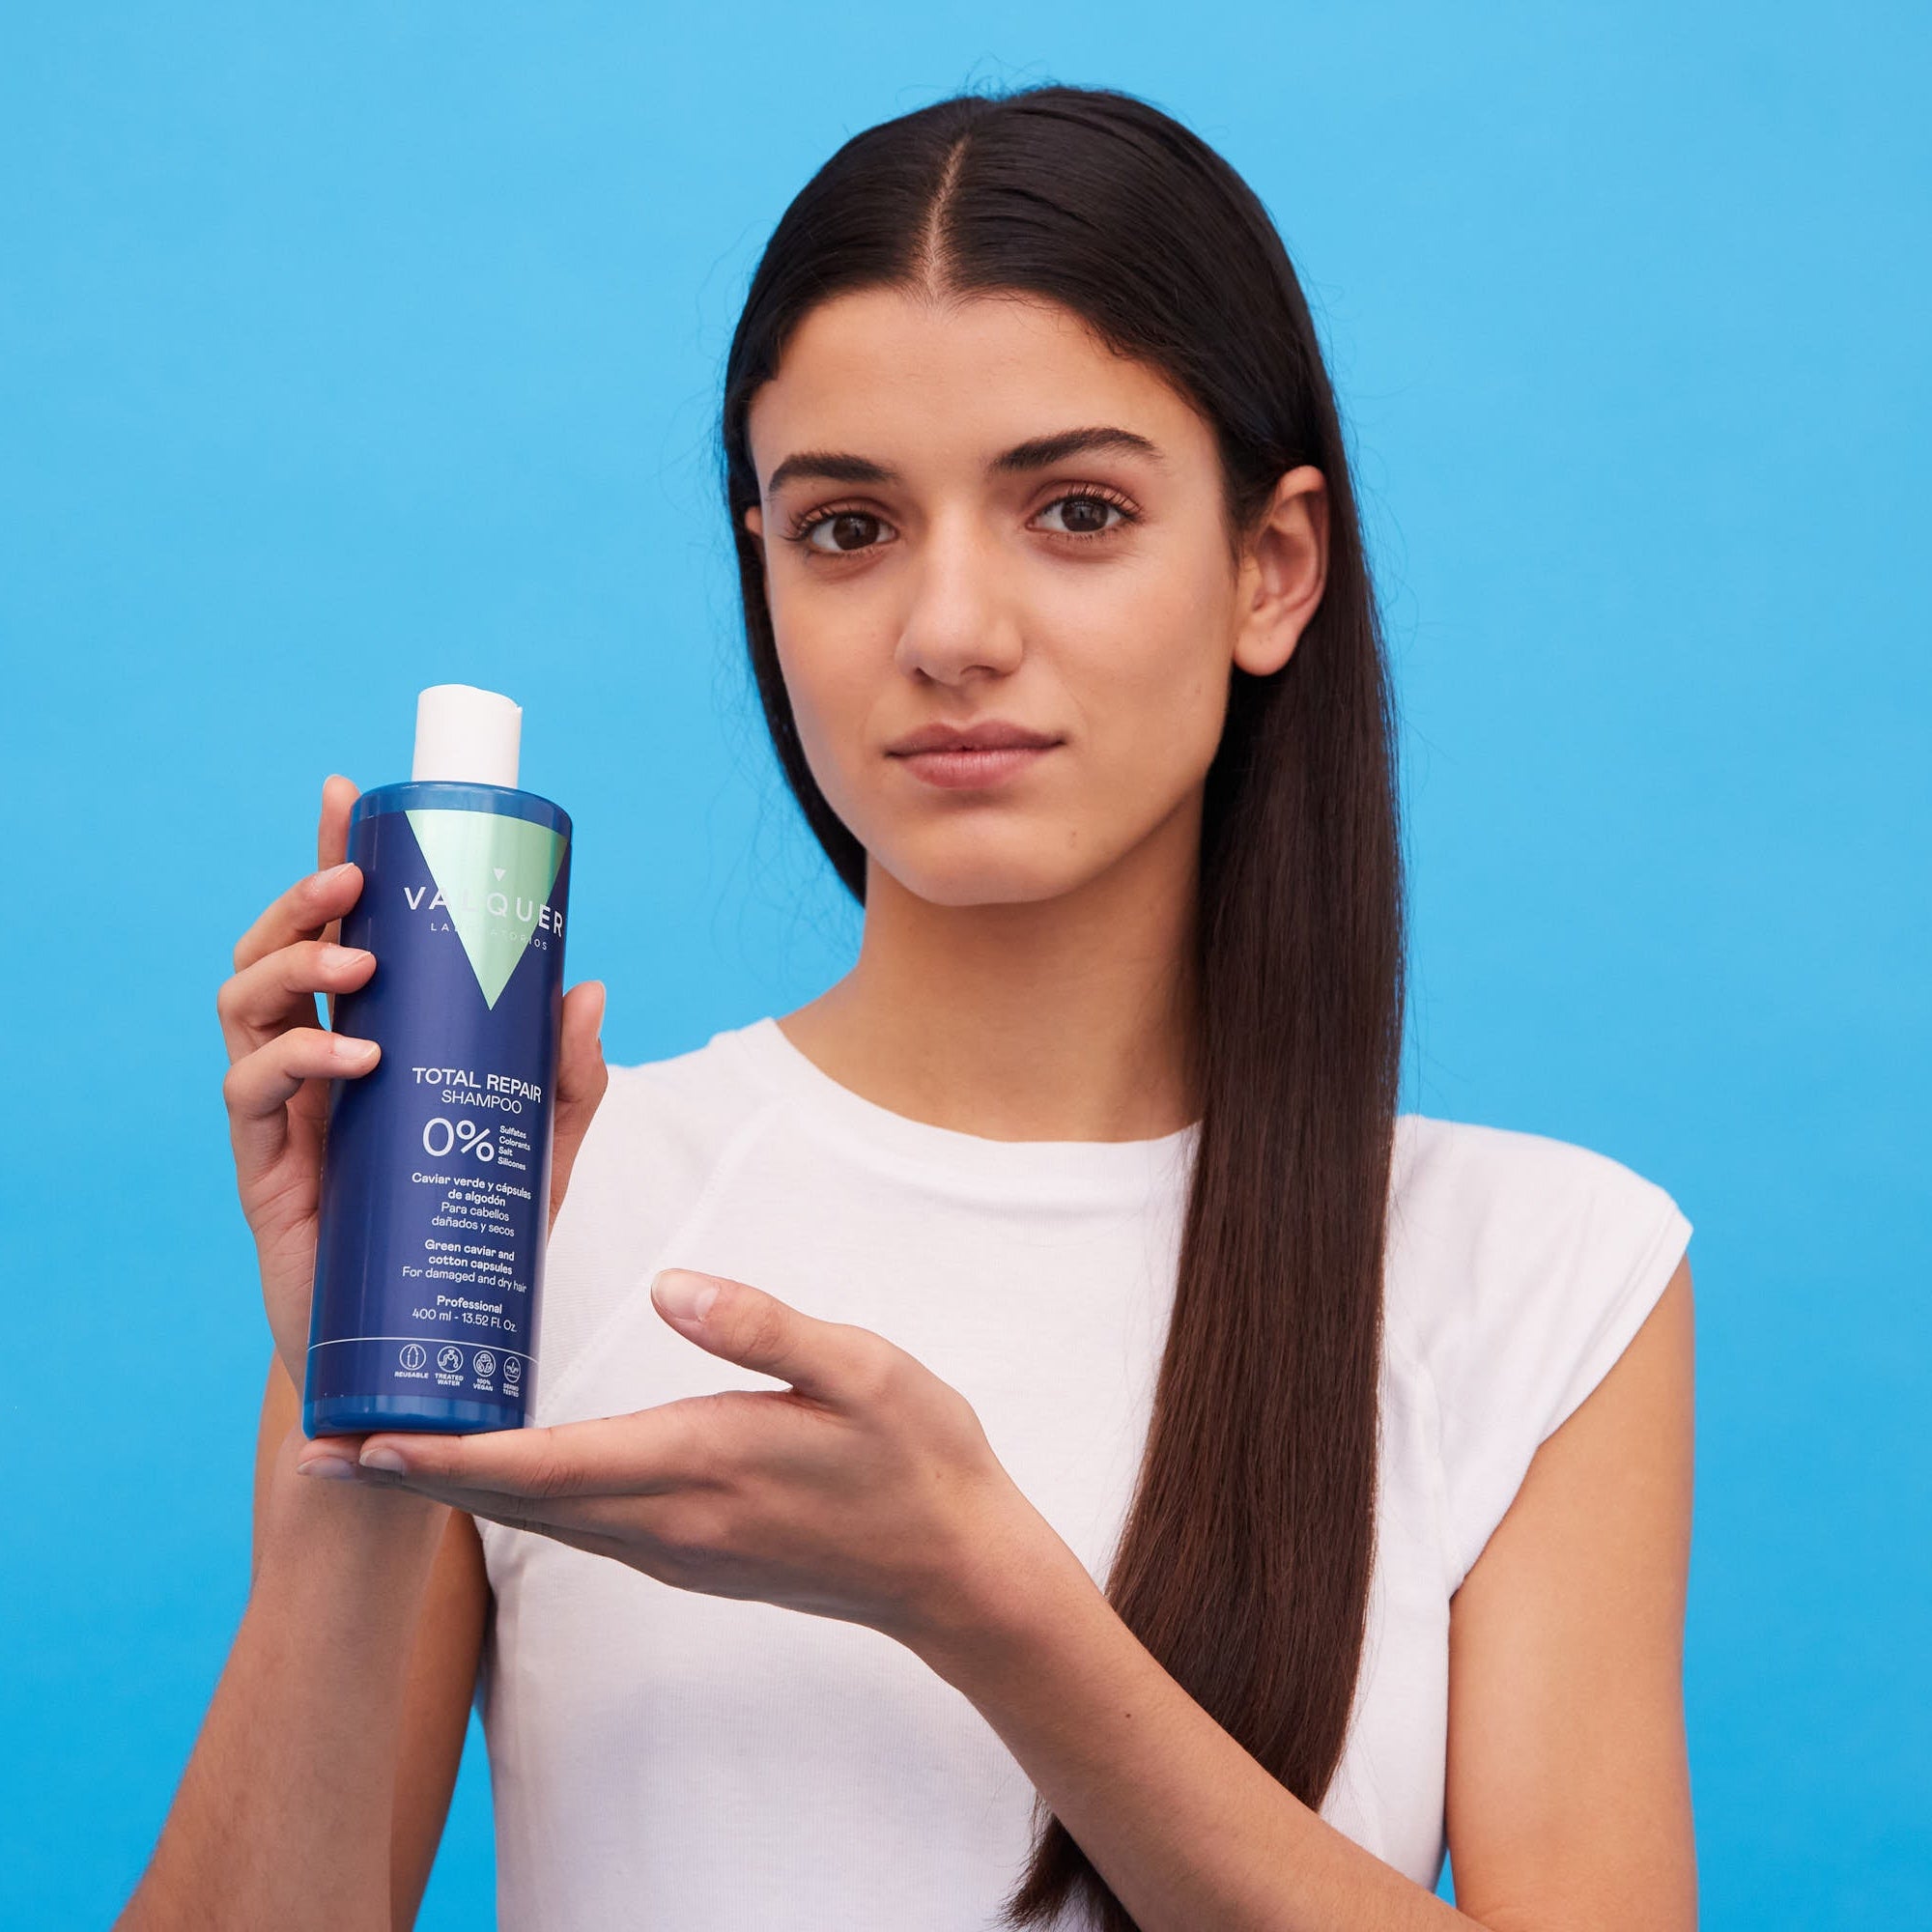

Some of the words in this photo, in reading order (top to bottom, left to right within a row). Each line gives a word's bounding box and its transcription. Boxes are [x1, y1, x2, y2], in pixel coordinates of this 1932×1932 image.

[404, 887, 563, 937] VALQUER
[412, 1067, 481, 1088] TOTAL
[487, 1073, 542, 1103] REPAIR
[441, 1090, 523, 1114] SHAMPOO
[422, 1118, 495, 1162] 0%
[499, 1125, 526, 1139] Sulfates
[498, 1136, 531, 1151] Colorants
[498, 1147, 513, 1156] Salt
[497, 1156, 526, 1171] Silicones
[412, 1172, 450, 1184] Caviar
[454, 1177, 485, 1188] verde
[488, 1182, 494, 1192] y
[496, 1182, 531, 1200] cápsulas
[448, 1189, 462, 1201] de
[465, 1191, 506, 1207] algodón
[440, 1202, 468, 1214] Para
[469, 1207, 510, 1222] cabellos
[431, 1216, 478, 1231] dañados
[480, 1223, 487, 1233] y
[489, 1225, 515, 1237] secos
[424, 1238, 462, 1253] Green
[464, 1245, 497, 1258] caviar
[497, 1251, 515, 1262] and
[428, 1256, 469, 1267] cotton
[470, 1260, 513, 1275] capsules
[402, 1266, 423, 1277] For
[425, 1267, 475, 1283] damaged
[477, 1274, 497, 1286] and
[497, 1277, 513, 1292] dry
[514, 1280, 527, 1293] hair
[437, 1294, 502, 1315] Professional
[412, 1308, 437, 1321] 400
[439, 1311, 452, 1321] ml
[462, 1313, 489, 1326] 13.52
[491, 1318, 501, 1329] Fl.
[435, 1373, 464, 1381] TREATED
[472, 1383, 494, 1392] VEGAN
